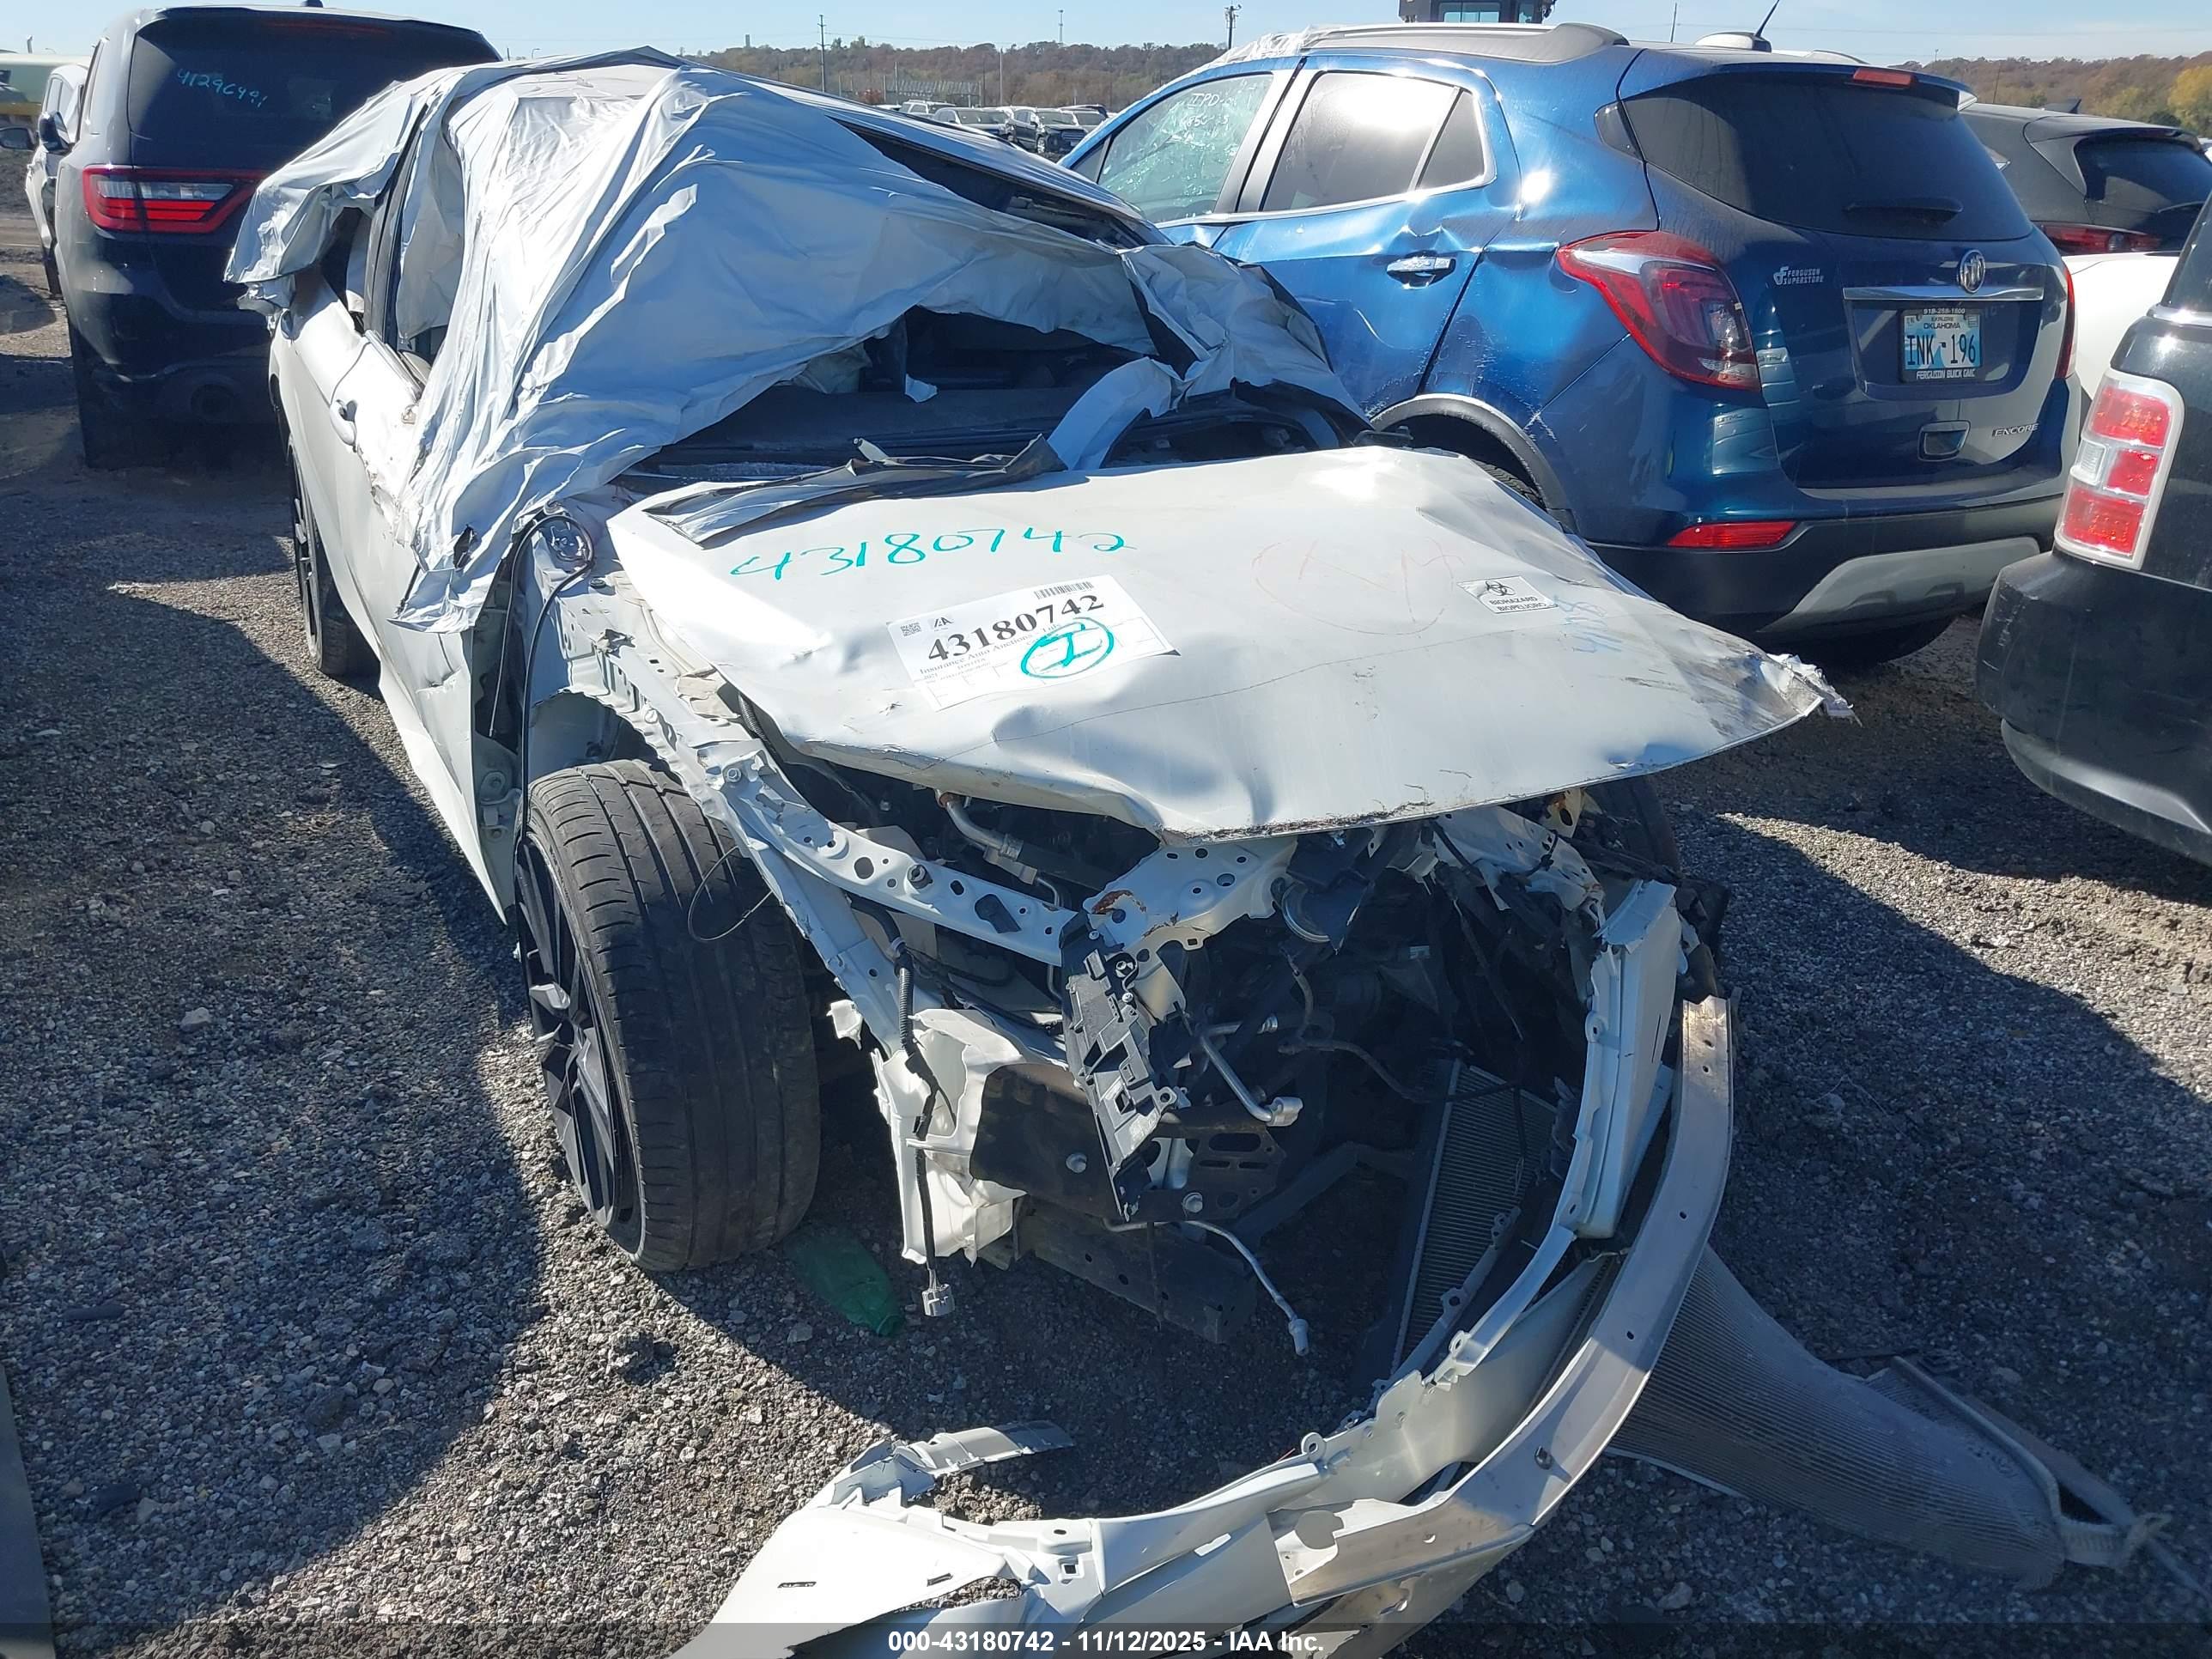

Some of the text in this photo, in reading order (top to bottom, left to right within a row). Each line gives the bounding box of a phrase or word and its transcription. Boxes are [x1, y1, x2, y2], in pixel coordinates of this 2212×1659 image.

[1787, 268, 1820, 276] FERGUSON
[1783, 276, 1824, 285] SUPERSTORE
[1916, 370, 1946, 380] FERGUSON
[1946, 368, 1962, 379] BUICK
[1992, 423, 2040, 437] ENCORE
[731, 527, 1138, 580] 43180742
[1489, 596, 1538, 605] BIOHAZARD
[927, 594, 1105, 660] 43180742
[920, 656, 966, 675] Insurance
[968, 649, 991, 660] Auto
[994, 635, 1033, 653] Auctions
